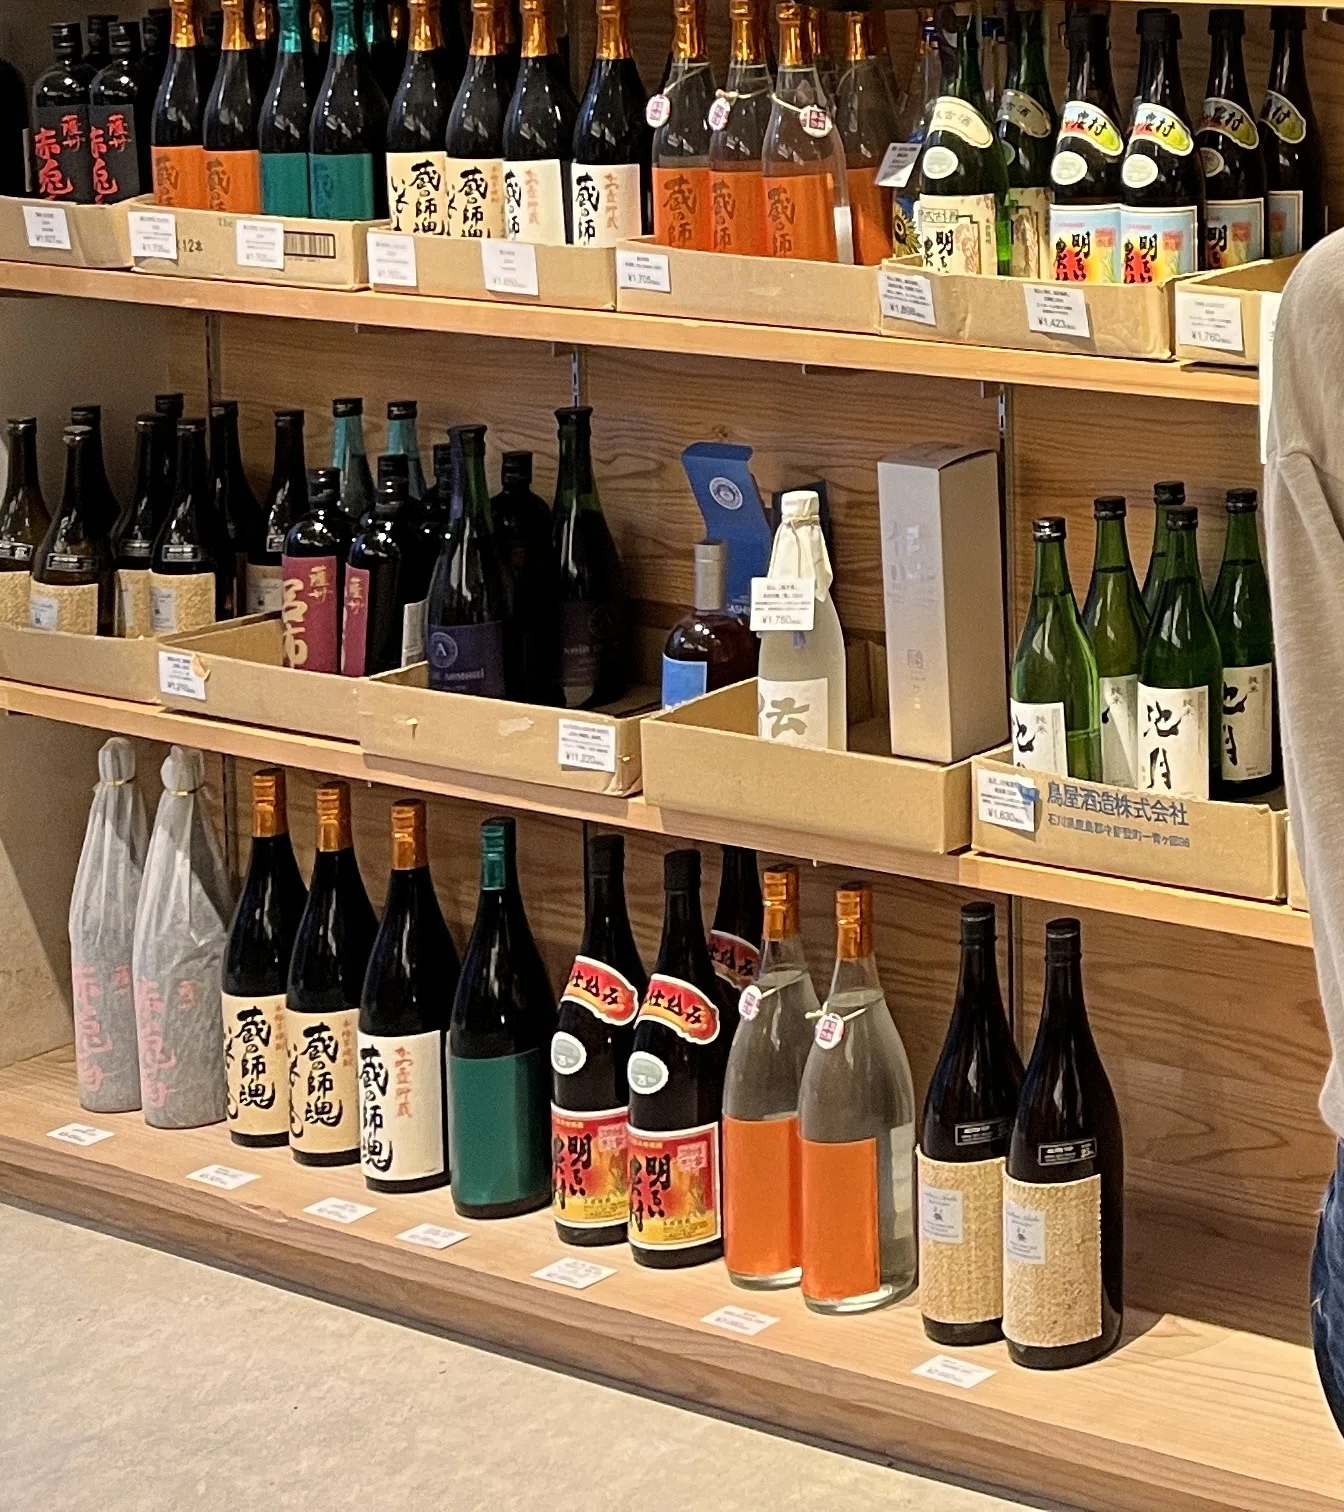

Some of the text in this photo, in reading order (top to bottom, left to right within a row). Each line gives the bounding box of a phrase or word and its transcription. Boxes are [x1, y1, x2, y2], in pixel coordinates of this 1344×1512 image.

[35, 127, 74, 201] 赤兎
[1143, 700, 1183, 790] 池月
[235, 1006, 276, 1109] 蔵の師魂
[301, 1022, 344, 1127] 蔵の師魂
